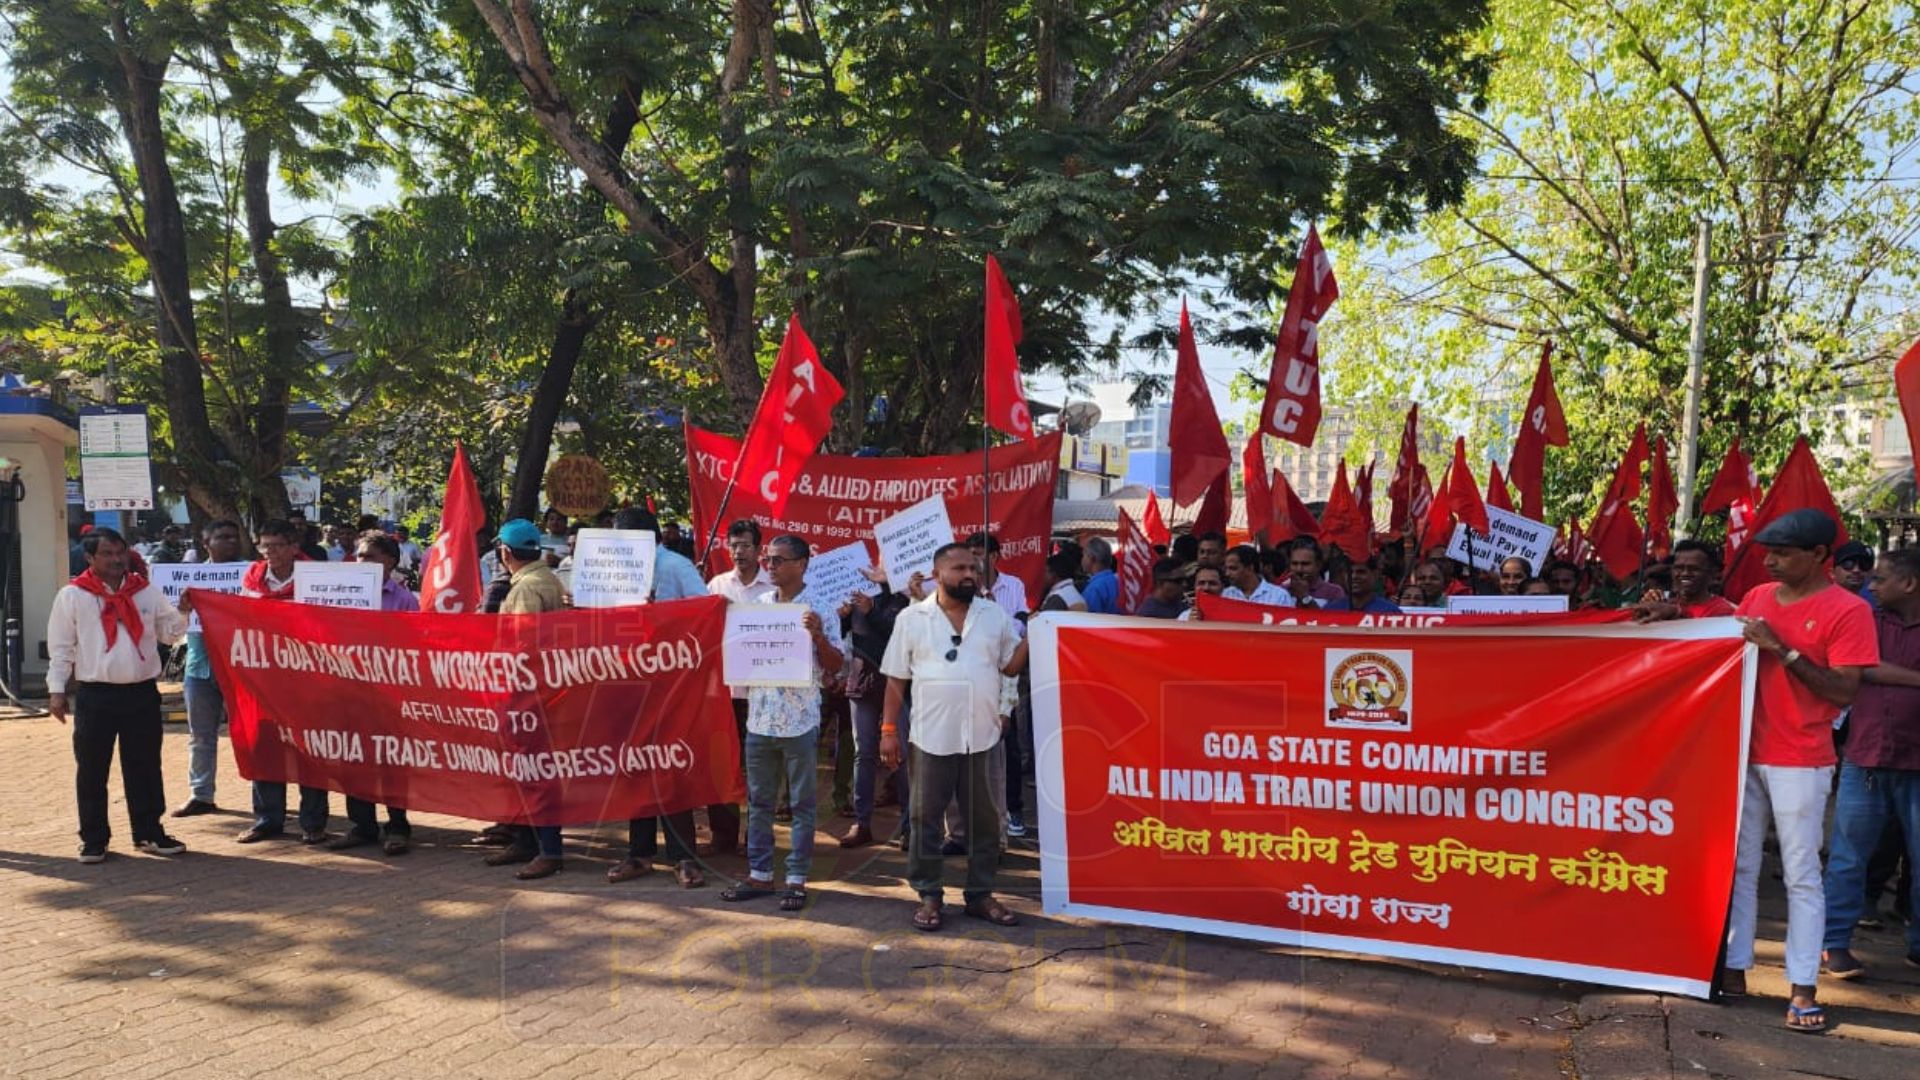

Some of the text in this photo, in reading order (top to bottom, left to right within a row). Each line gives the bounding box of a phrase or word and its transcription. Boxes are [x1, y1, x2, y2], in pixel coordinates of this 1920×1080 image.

[695, 451, 728, 481] KTC
[797, 473, 814, 496] &
[816, 475, 870, 500] ALLIED
[873, 477, 957, 502] EMPLOYEES
[827, 526, 851, 537] 1992
[1459, 539, 1491, 560] Eual
[1492, 518, 1538, 543] demand
[1497, 536, 1518, 555] Pay
[1521, 545, 1537, 560] for
[171, 569, 239, 581] We demand
[230, 629, 270, 669] ALL
[309, 641, 422, 687] PANCHAYAT
[427, 650, 537, 693] WORKERS
[540, 644, 628, 689] UNION
[627, 632, 701, 678] (GOA)
[400, 700, 538, 735] AFFILIATED TO
[302, 728, 364, 763] INDIA
[371, 734, 443, 770] TRADE
[442, 742, 501, 777] UNION
[502, 745, 617, 783] CONGRESS
[619, 738, 695, 779] (AITUC)
[1203, 732, 1548, 776] GOA STATE COMMITTEE
[1107, 764, 1675, 836] ALL INDIA TRADE UNION CONGRESS
[1113, 816, 1212, 855] अखिल
[1220, 826, 1341, 864] भारतीय
[1348, 829, 1400, 874] ट्रेड
[1408, 838, 1539, 883] युनियन
[1284, 883, 1453, 929] गोवा राज्य
